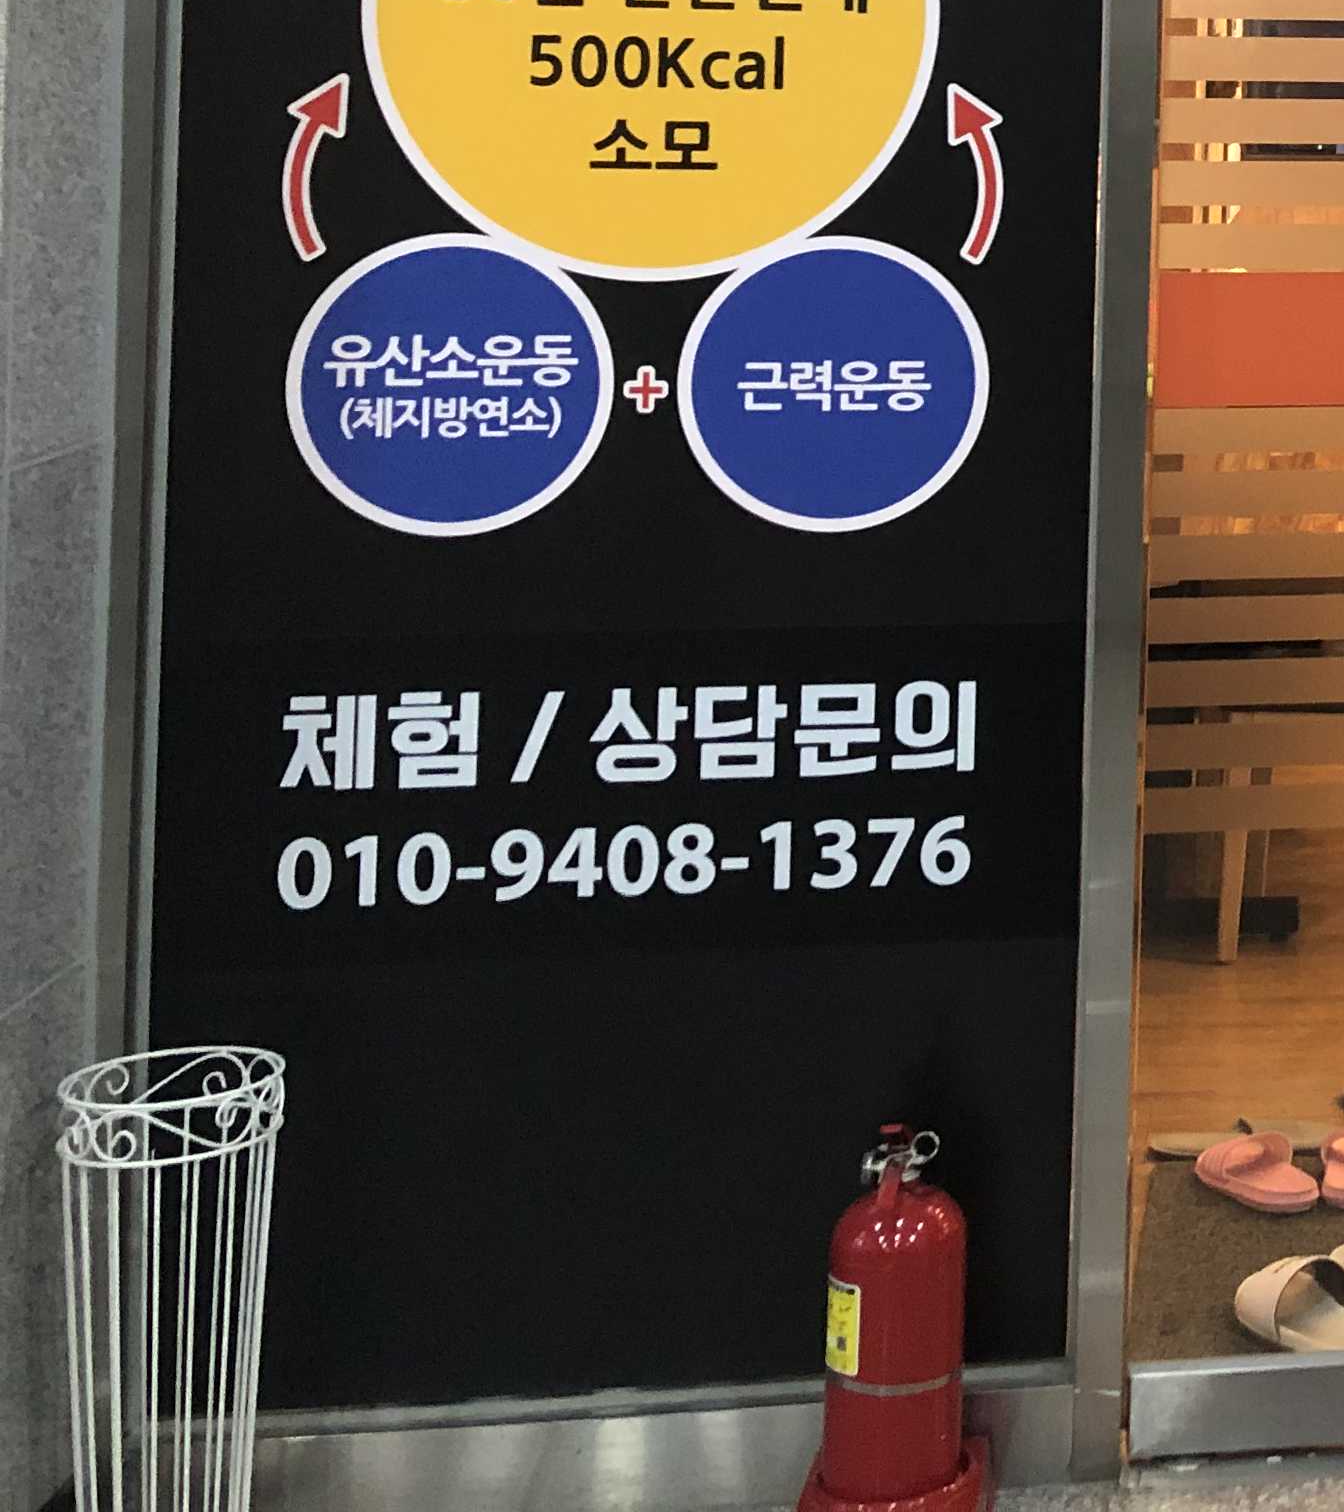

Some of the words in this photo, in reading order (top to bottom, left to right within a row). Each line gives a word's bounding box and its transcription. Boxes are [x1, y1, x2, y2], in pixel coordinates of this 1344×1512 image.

[530, 34, 786, 90] 500Kcal
[589, 119, 718, 171] 소모
[323, 334, 579, 388] 유산소운동
[736, 359, 932, 412] 근력운동
[338, 395, 563, 440] (체지방연소)
[278, 691, 480, 790] 체험
[588, 679, 978, 783] 상담문의
[276, 815, 973, 911] 010-9408-1376
